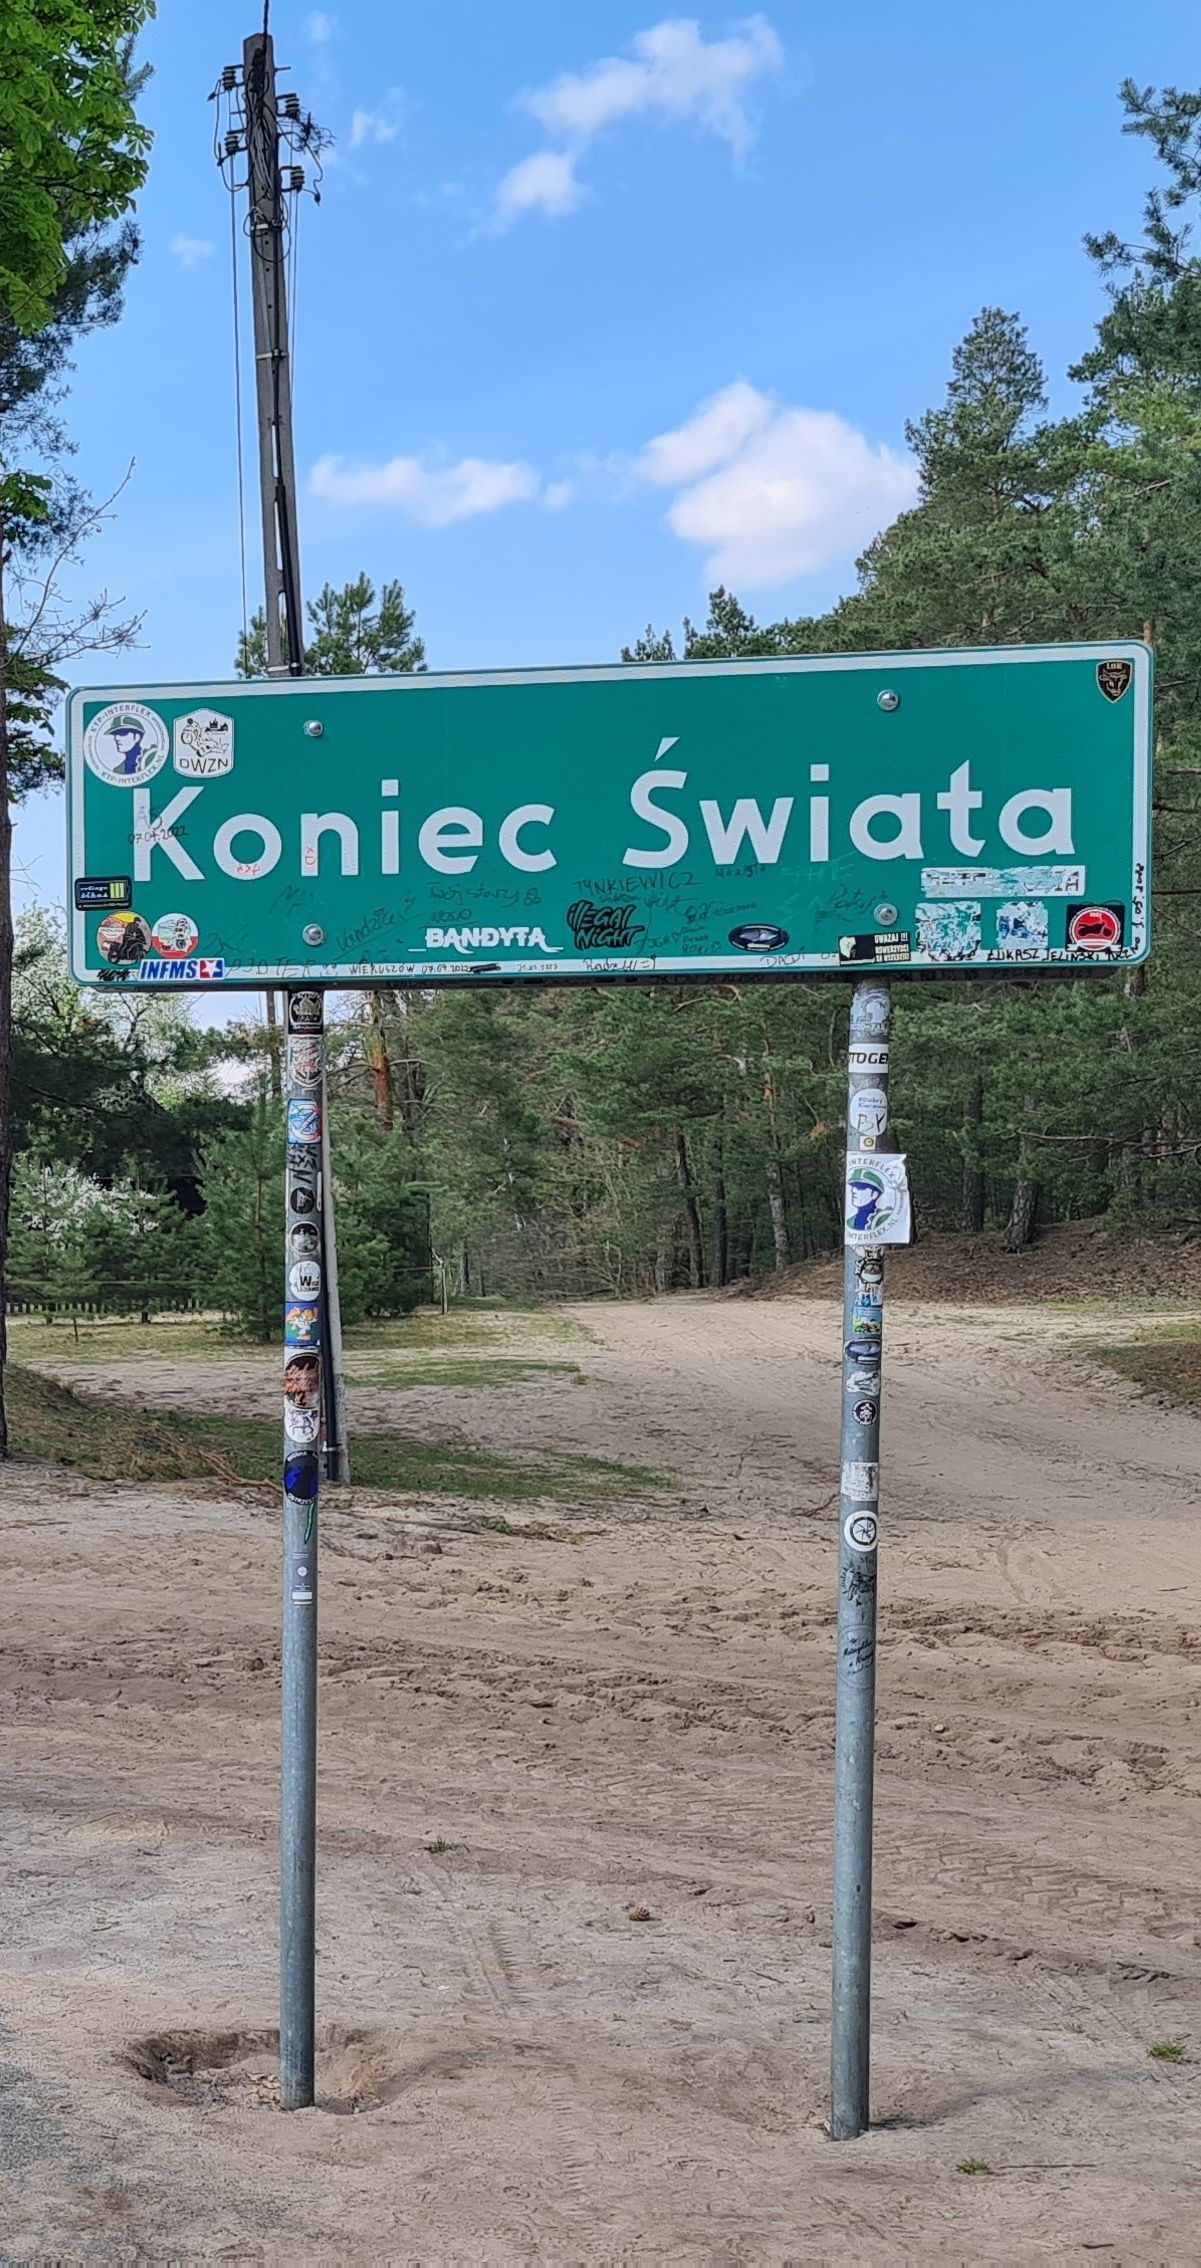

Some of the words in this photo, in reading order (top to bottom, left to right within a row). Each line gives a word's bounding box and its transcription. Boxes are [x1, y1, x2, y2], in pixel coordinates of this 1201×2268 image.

[133, 777, 558, 882] Koniec
[621, 735, 1076, 869] Świata
[425, 927, 561, 954] BANDYTA
[140, 960, 198, 979] INFMS
